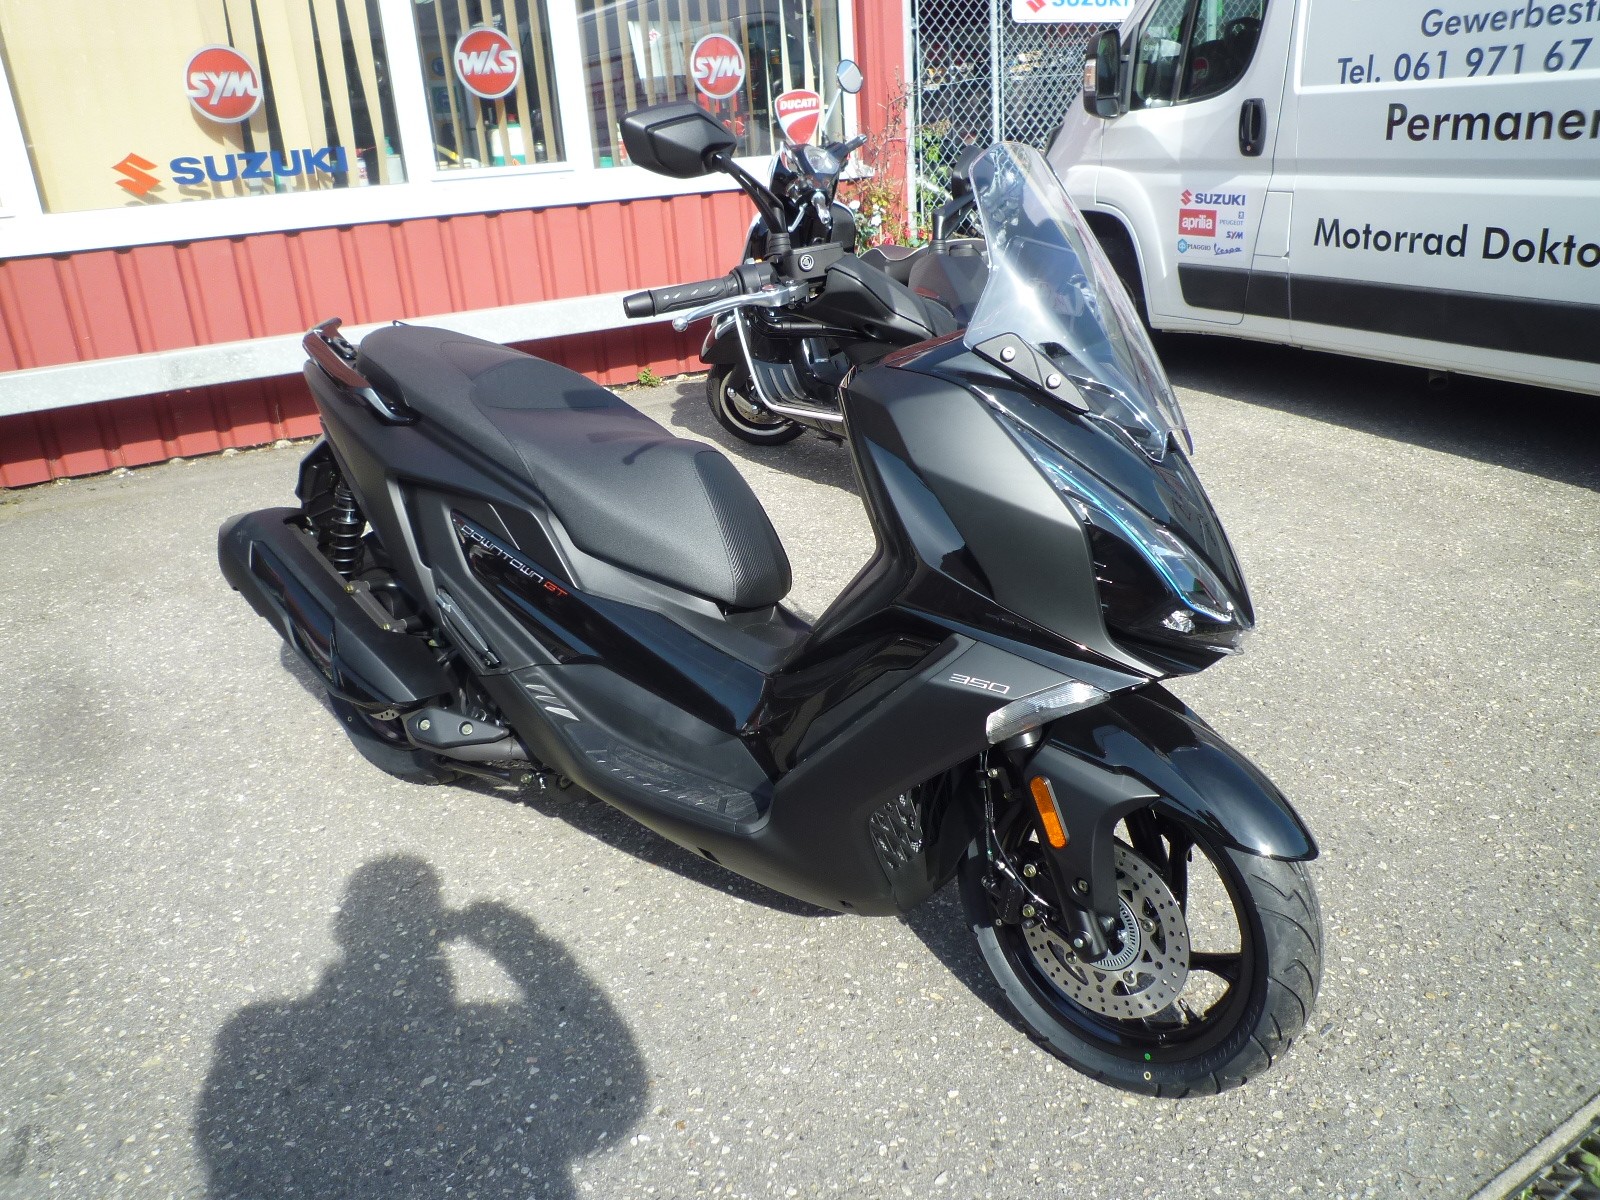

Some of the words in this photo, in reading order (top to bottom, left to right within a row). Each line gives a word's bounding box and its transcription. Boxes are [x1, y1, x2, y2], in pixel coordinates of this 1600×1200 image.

[1421, 0, 1600, 37] Gewerbest
[694, 56, 744, 84] SYM
[1337, 54, 1381, 84] Tel.
[1393, 50, 1448, 82] 061
[1465, 43, 1525, 78] 971
[1543, 37, 1593, 73] 67
[187, 70, 262, 106] SYM
[779, 97, 817, 110] DUCATI
[170, 146, 349, 185] SUZUKI
[1194, 192, 1246, 206] SUZUKI
[1181, 214, 1213, 231] aprilia
[1226, 231, 1243, 240] SYM
[1313, 217, 1468, 257] Motorrad
[1187, 243, 1211, 251] PIAGGIO
[1213, 243, 1242, 255] Vespa
[543, 580, 568, 598] GT
[949, 673, 1011, 695] 350
